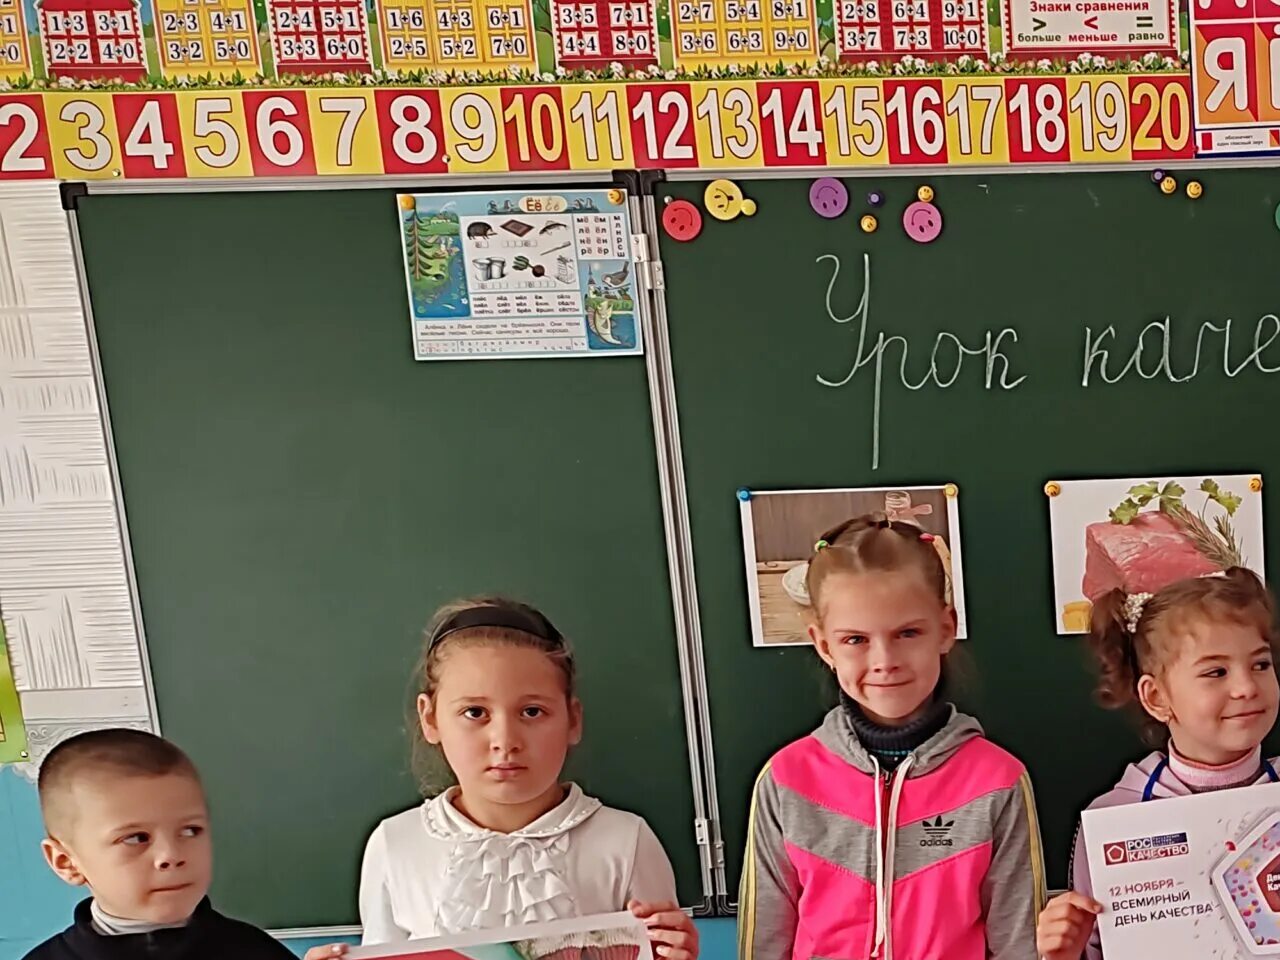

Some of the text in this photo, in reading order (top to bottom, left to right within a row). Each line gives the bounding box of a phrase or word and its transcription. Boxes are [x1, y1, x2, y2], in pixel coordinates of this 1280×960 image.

[1030, 1, 1149, 13] Знаки сравнения
[1018, 31, 1164, 44] больше меньше равно
[0, 81, 1189, 171] 2 3 4 5 6 7 8 9 10 11 12 13 14 15 16 17 18 19 20
[815, 252, 1028, 470] Урок
[919, 837, 953, 847] adidas
[1128, 839, 1151, 849] РОС
[1129, 846, 1188, 861] КАЧЕСТВО
[1109, 886, 1122, 897] 12
[1125, 878, 1175, 896] НОЯБРЯ
[1111, 890, 1191, 911] ВСЕМИРНЫЙ
[1114, 905, 1214, 927] ДЕНЬ КАЧЕСТВА
